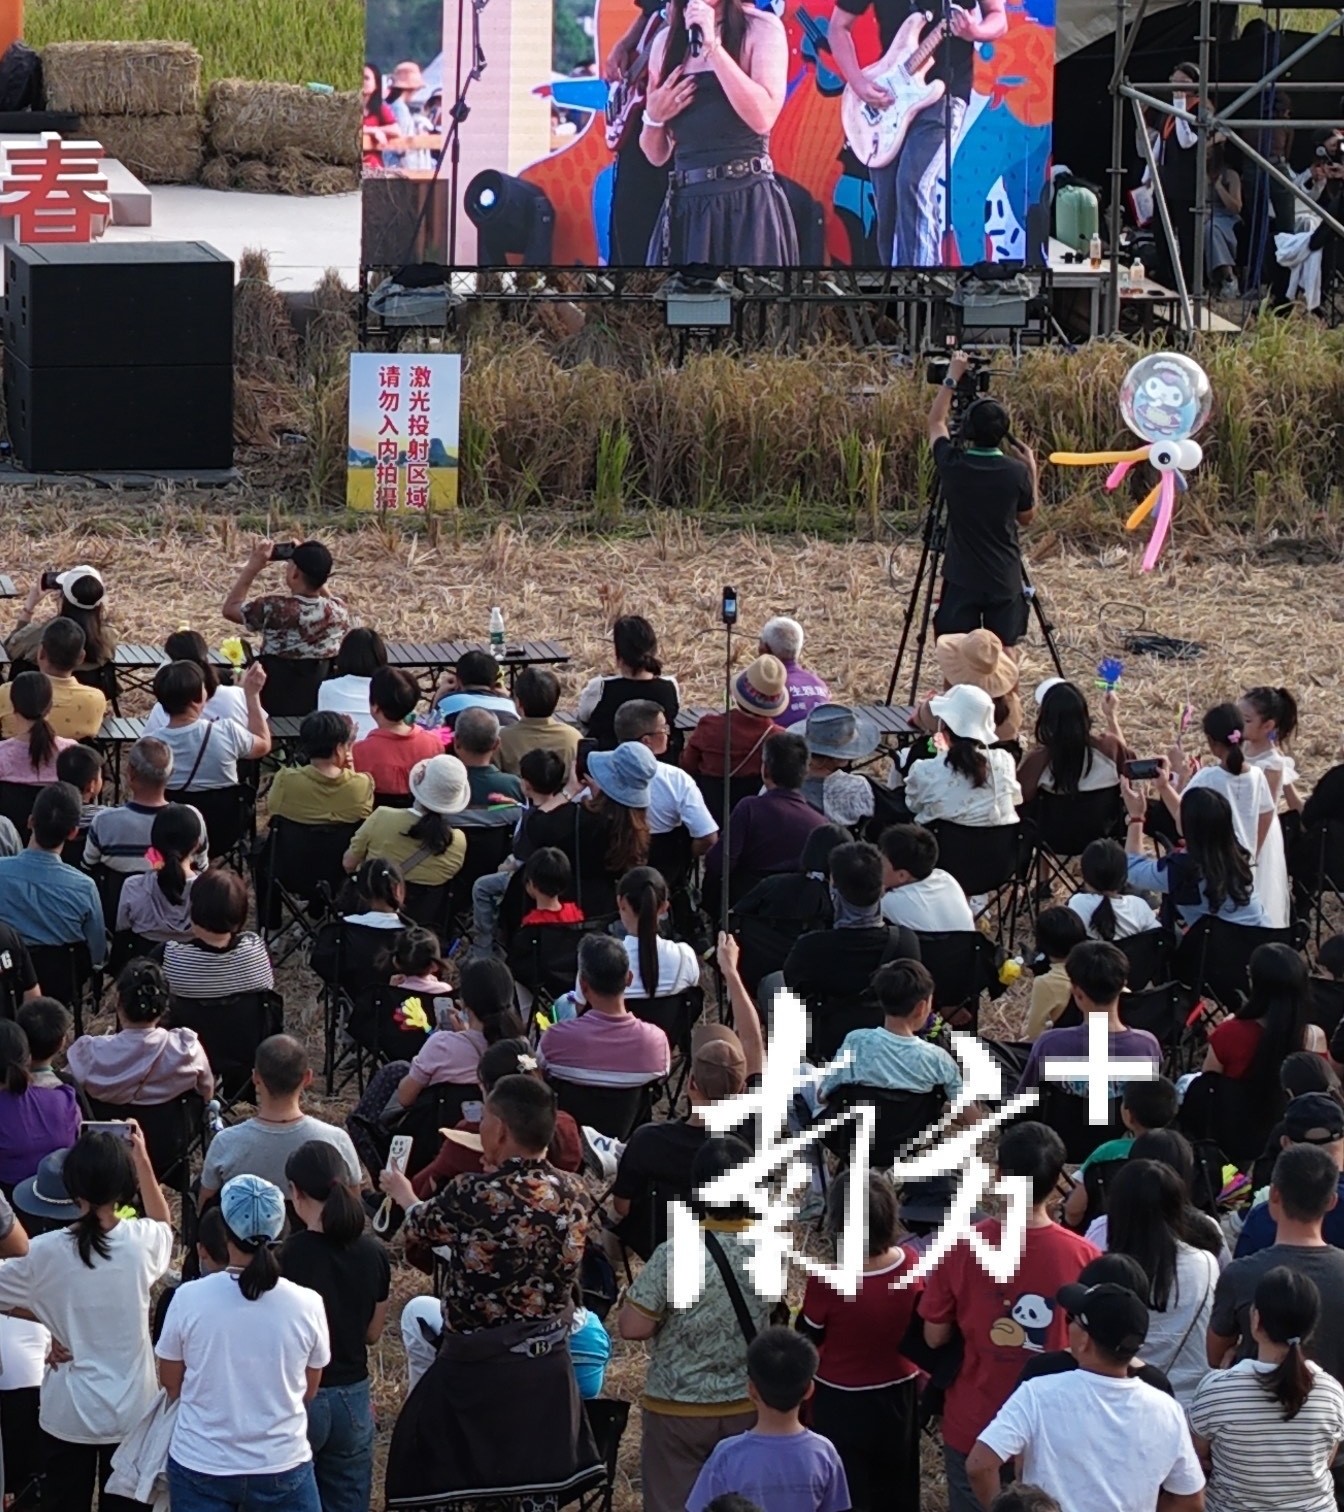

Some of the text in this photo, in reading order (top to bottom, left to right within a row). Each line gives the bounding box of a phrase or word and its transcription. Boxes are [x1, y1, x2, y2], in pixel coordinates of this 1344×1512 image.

[375, 365, 401, 508] 请勿入内拍摄
[405, 365, 432, 508] 激光投射区域
